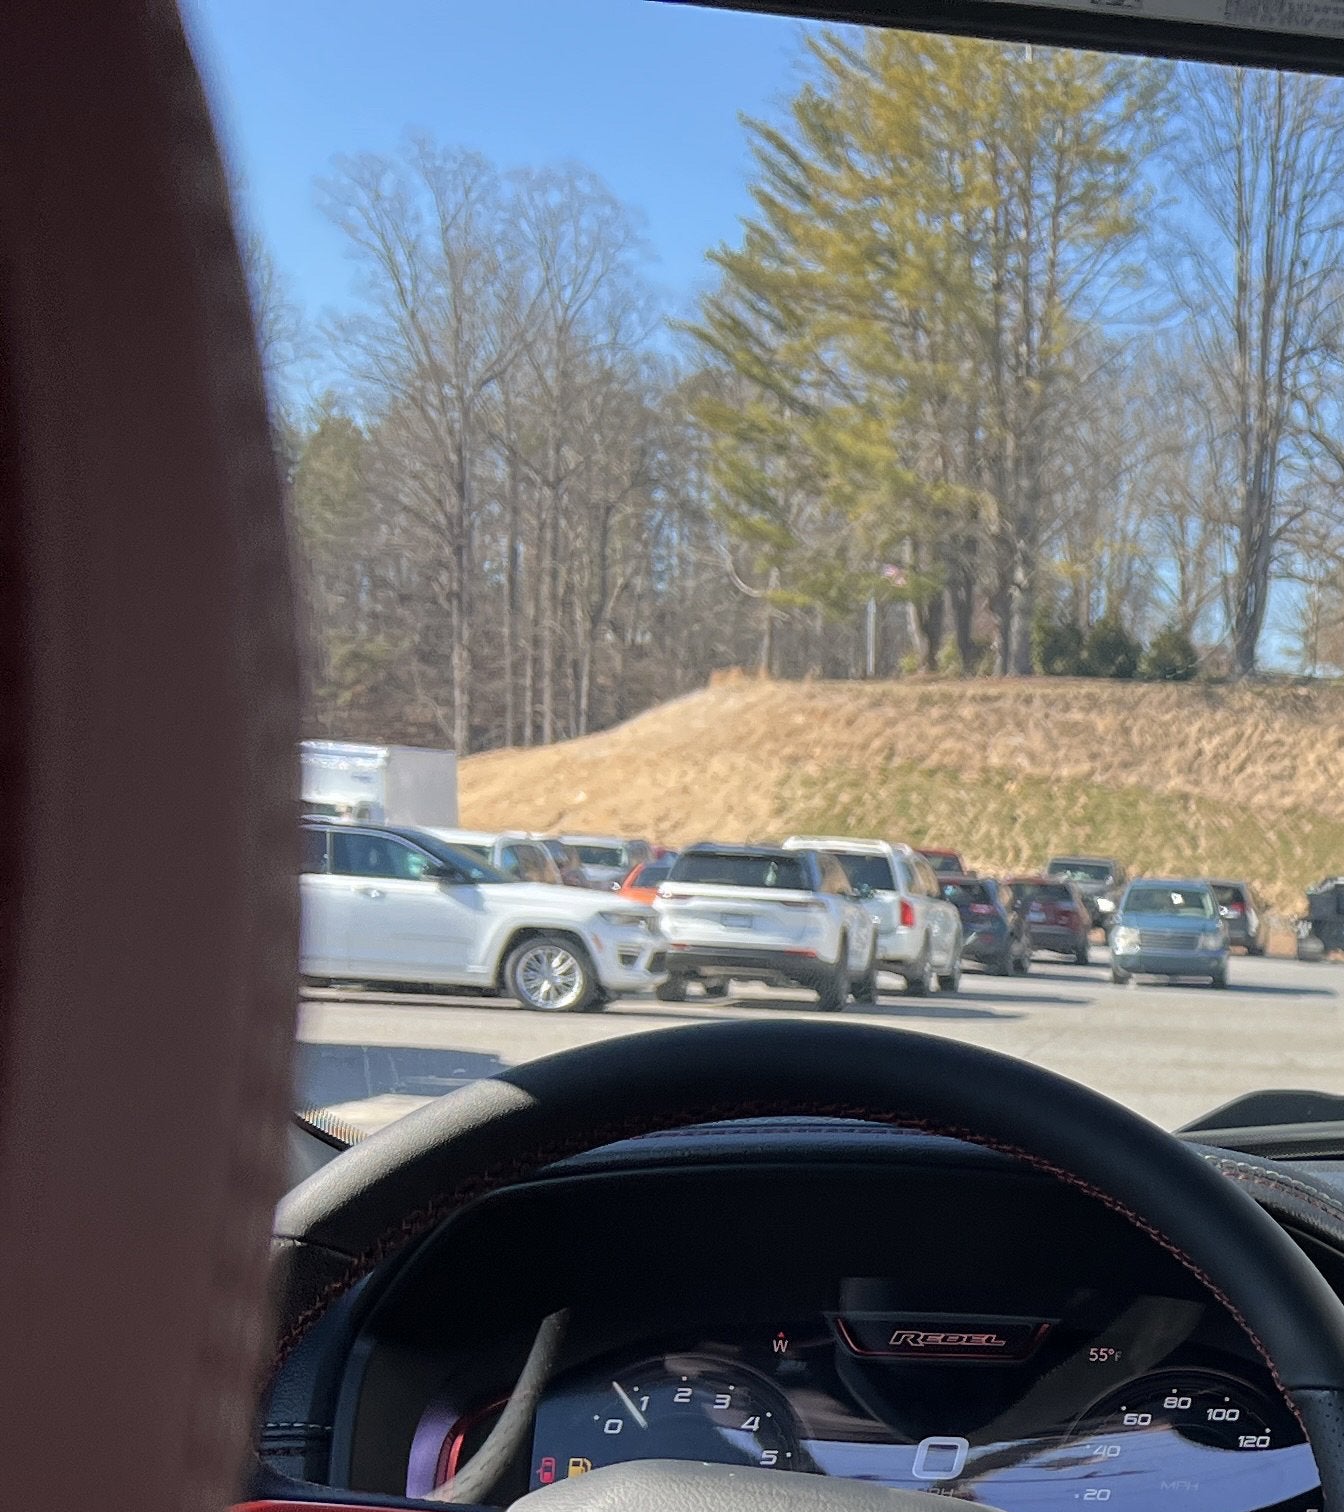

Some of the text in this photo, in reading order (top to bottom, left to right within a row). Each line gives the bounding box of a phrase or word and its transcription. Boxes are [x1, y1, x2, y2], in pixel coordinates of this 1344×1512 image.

[772, 1338, 790, 1354] W
[888, 1329, 1007, 1348] REBEL
[639, 1395, 651, 1412] 1
[672, 1387, 694, 1404] 2
[712, 1393, 732, 1410] 3
[1163, 1395, 1193, 1411] 80
[740, 1415, 761, 1432] 4
[1122, 1411, 1153, 1427] 60
[1205, 1407, 1241, 1423] 100
[603, 1418, 624, 1435] 0
[1236, 1434, 1272, 1450] 120
[759, 1449, 780, 1466] 5
[911, 1435, 971, 1482] 0
[1092, 1443, 1122, 1460] 40
[1159, 1478, 1200, 1493] MPH
[1082, 1487, 1113, 1503] 20
